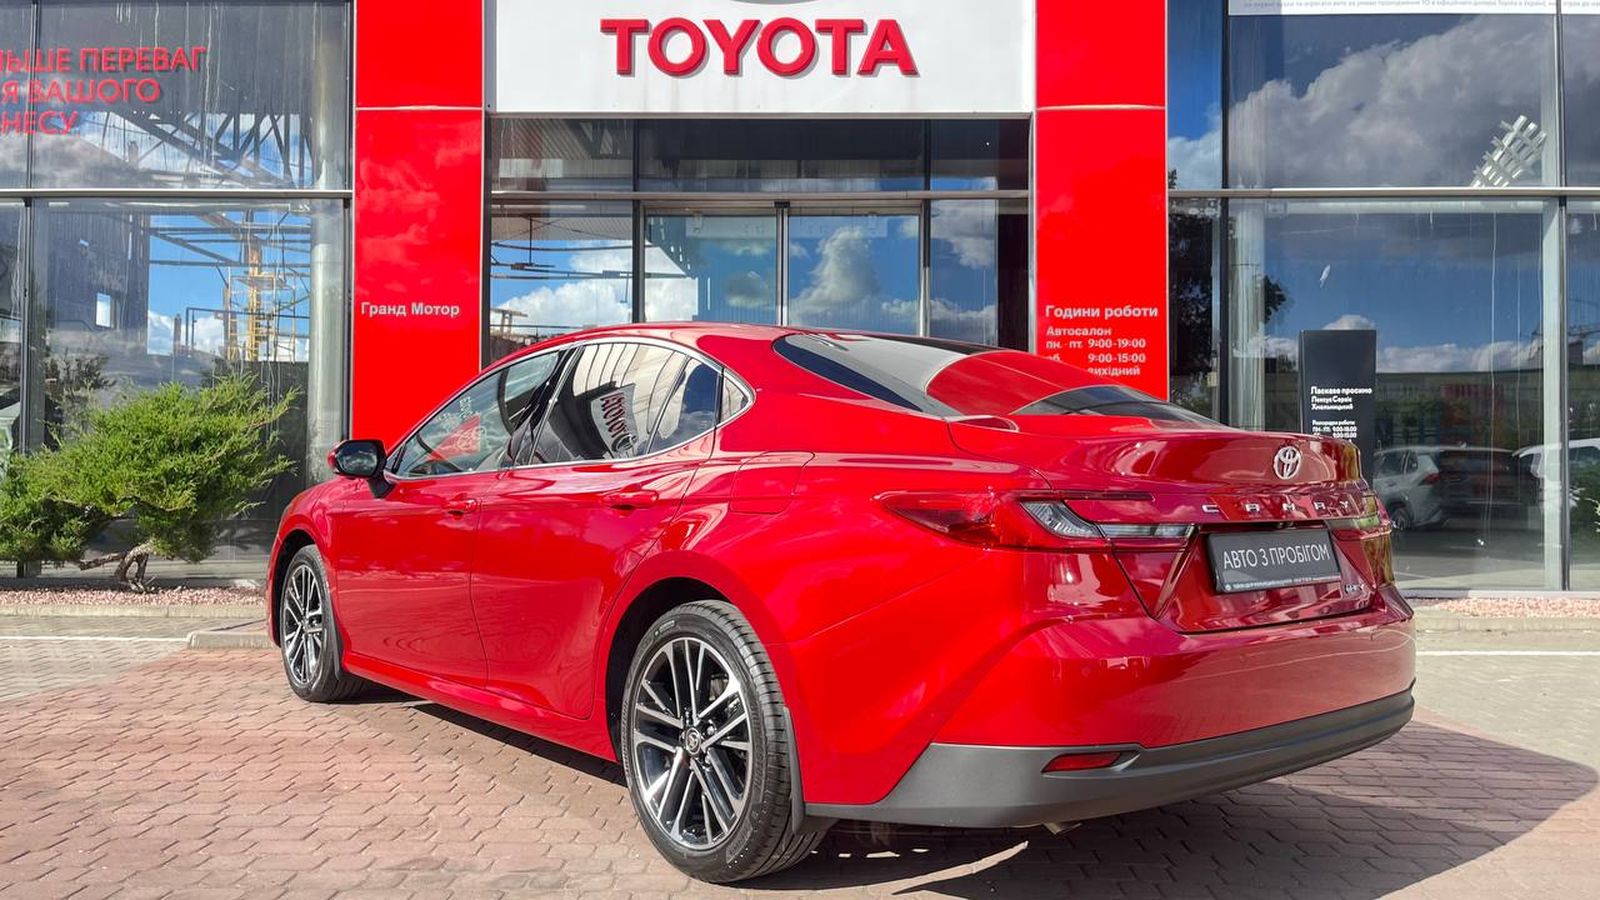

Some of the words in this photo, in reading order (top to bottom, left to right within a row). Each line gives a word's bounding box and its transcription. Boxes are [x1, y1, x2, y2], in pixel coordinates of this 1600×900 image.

[600, 17, 919, 77] TOYOTA
[80, 47, 207, 72] ПЕРЕВАГ
[29, 78, 161, 104] ВАШОГО
[361, 302, 407, 318] Гранд
[411, 302, 460, 318] Мотор
[1045, 305, 1100, 319] Години
[1104, 305, 1158, 320] роботи
[1046, 326, 1111, 336] Автосалон
[1202, 500, 1349, 513] CAMRY
[1224, 550, 1258, 570] АВТО
[1270, 544, 1330, 564] ПРОБІГОМ
